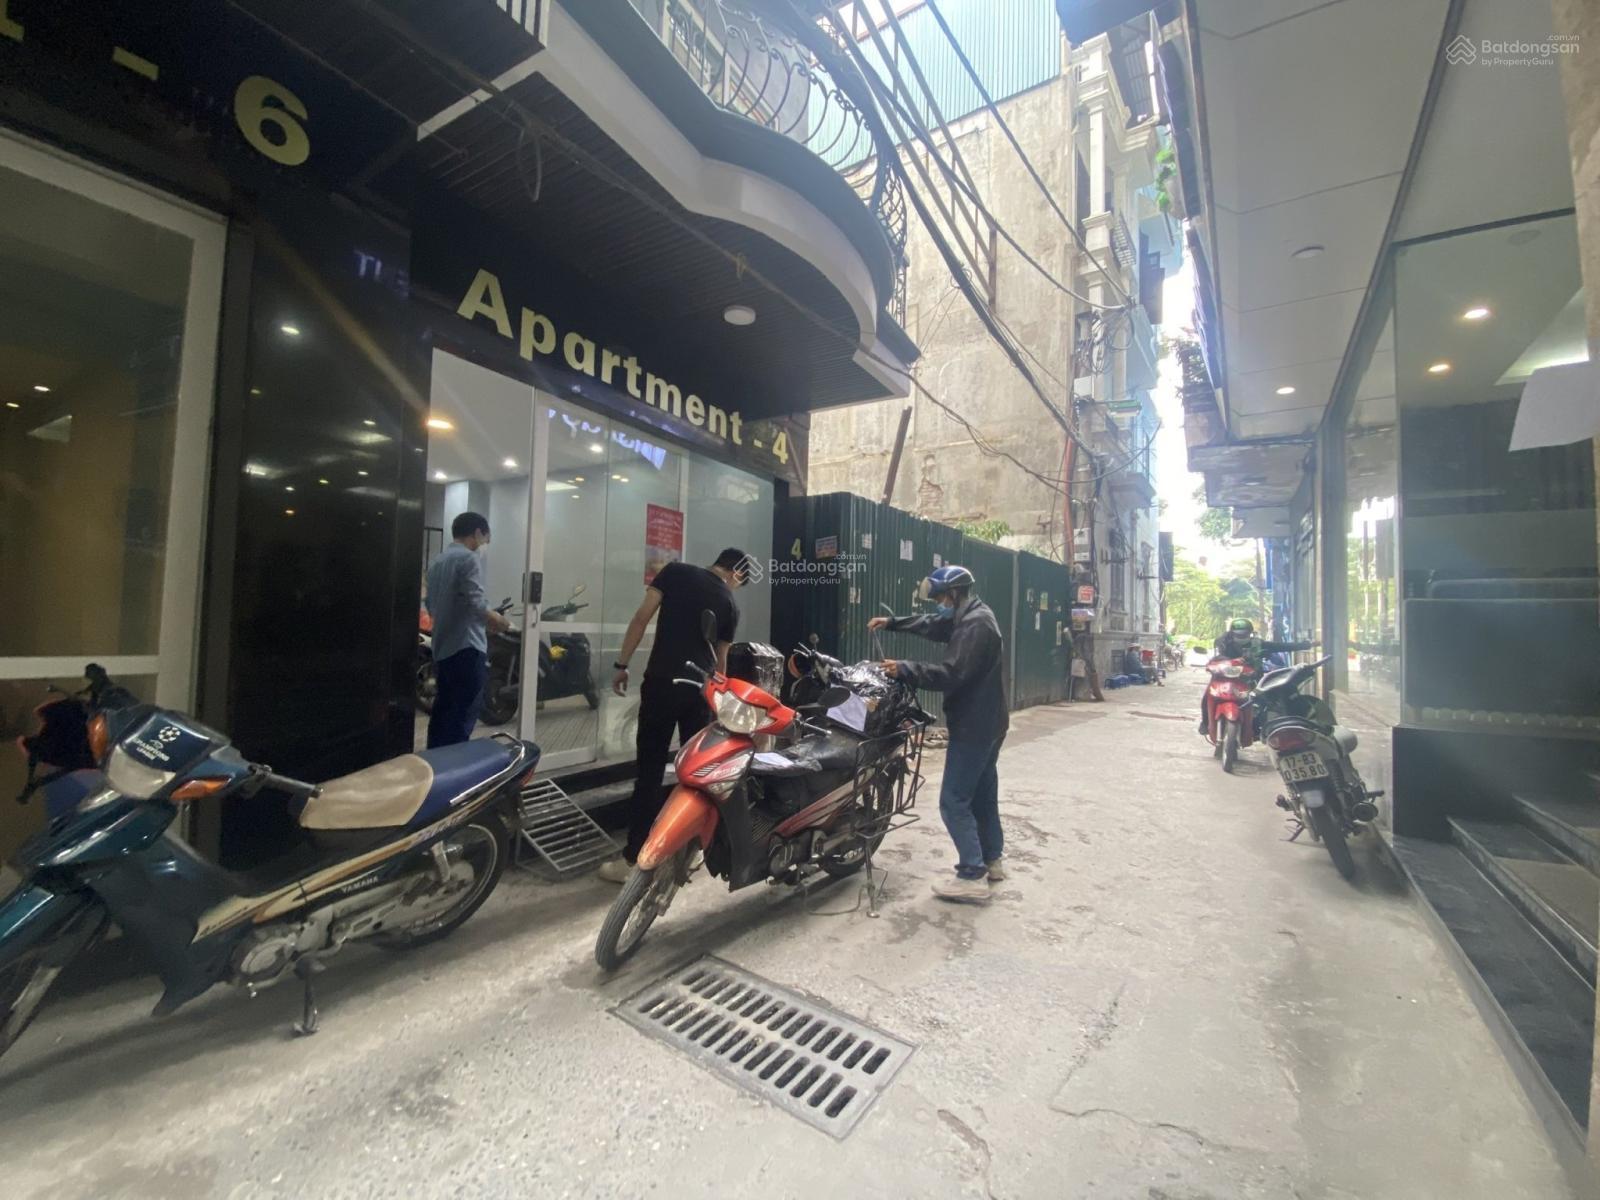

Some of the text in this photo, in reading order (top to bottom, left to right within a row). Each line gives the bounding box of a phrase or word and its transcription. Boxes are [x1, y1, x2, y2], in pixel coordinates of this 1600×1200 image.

[233, 75, 310, 166] 6
[456, 268, 743, 446] Apartment
[772, 431, 788, 464] 4
[791, 538, 802, 560] 4
